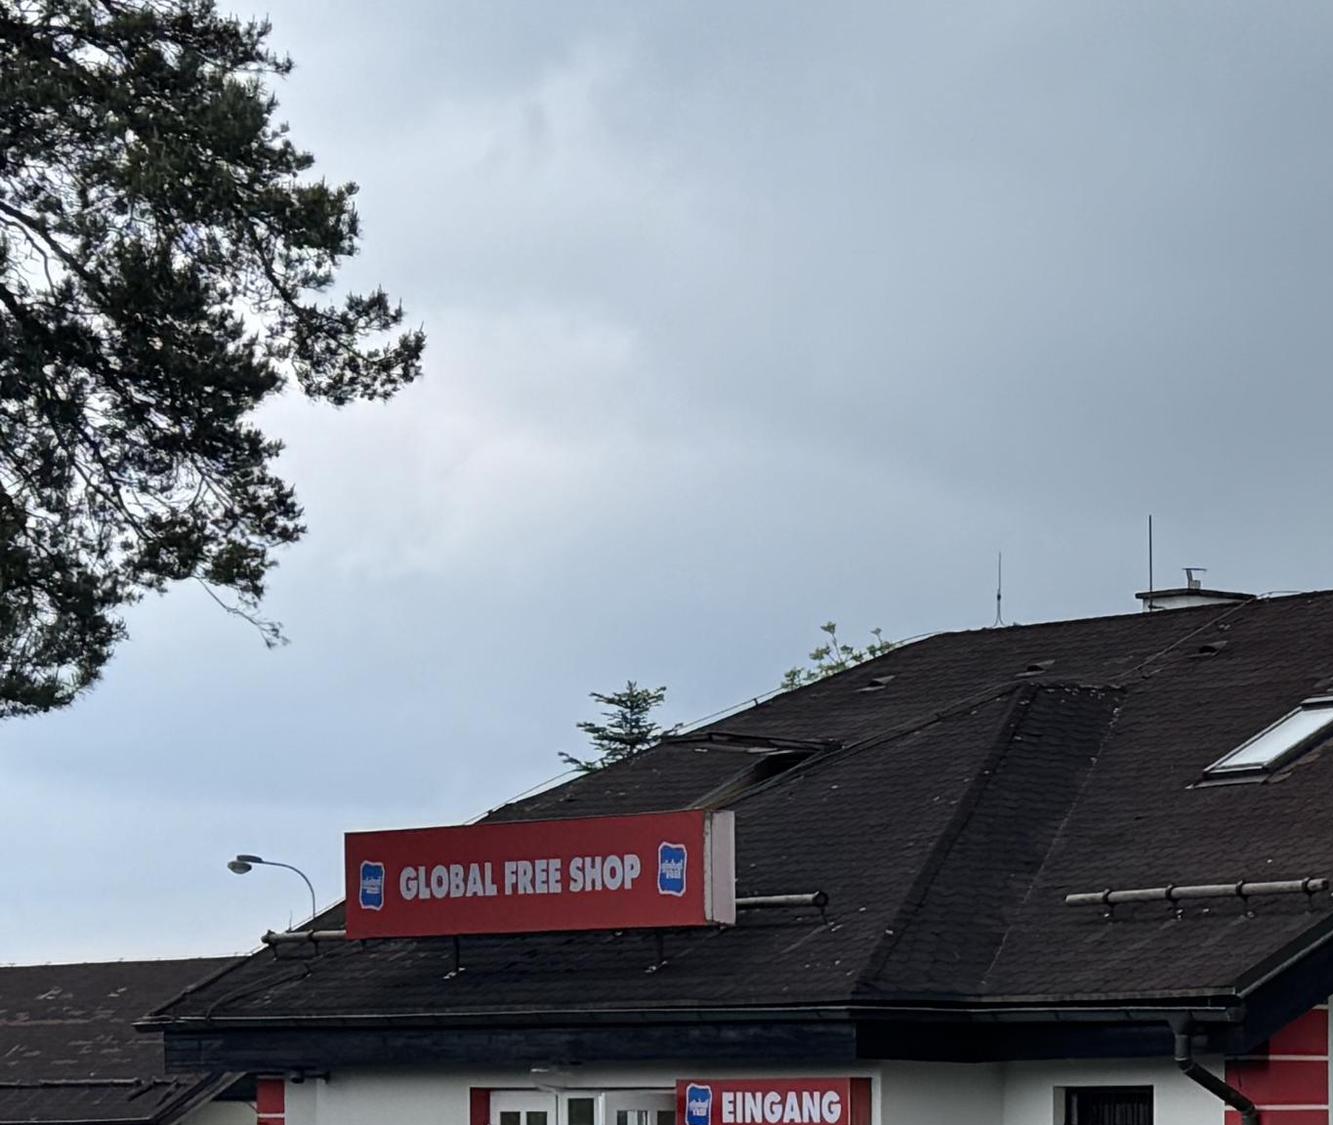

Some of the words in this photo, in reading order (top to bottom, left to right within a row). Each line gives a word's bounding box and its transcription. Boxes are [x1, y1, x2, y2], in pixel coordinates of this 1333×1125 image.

[400, 862, 498, 901] GLOBAL
[504, 858, 562, 896] FREE
[568, 853, 641, 893] SHOP
[721, 1090, 842, 1124] EINGANG
